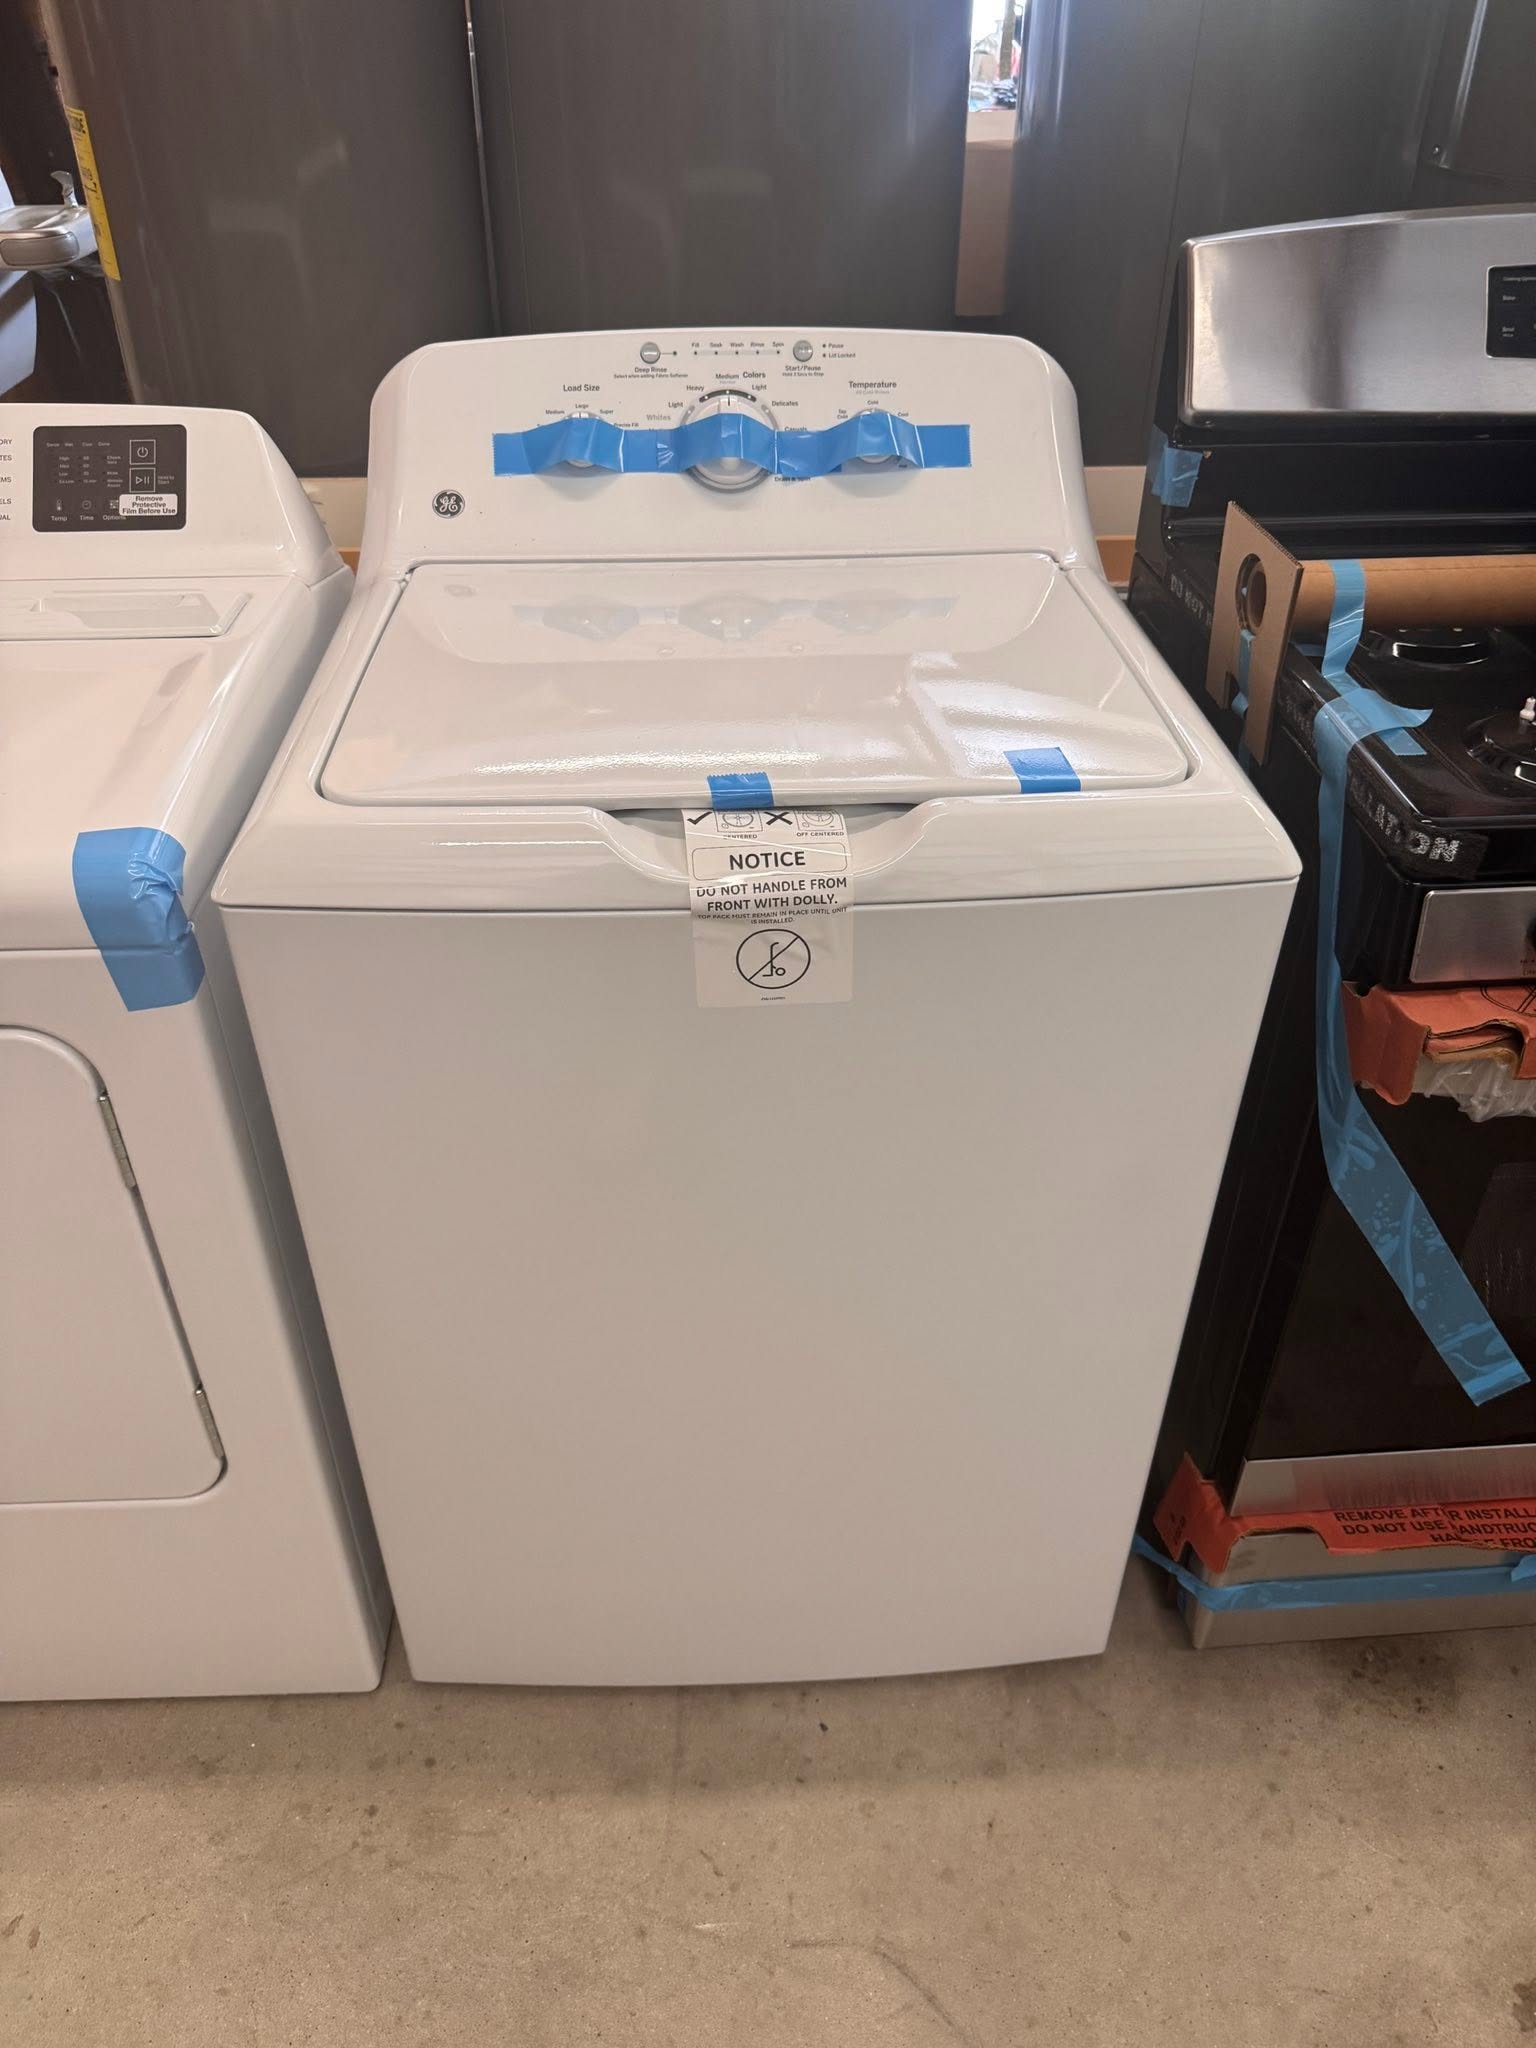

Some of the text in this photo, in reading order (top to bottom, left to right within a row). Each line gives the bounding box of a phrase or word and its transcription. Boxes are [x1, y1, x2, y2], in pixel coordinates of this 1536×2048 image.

[742, 371, 766, 379] Colors
[563, 384, 600, 392] Load Size
[686, 384, 704, 392] Heavy
[751, 384, 767, 392] Light
[848, 380, 897, 389] Temperature
[668, 401, 683, 409] Light
[729, 851, 806, 871] NOTICE
[696, 877, 847, 897] DO NOT HANDLE FROM
[707, 893, 838, 912] FRONT WITH DOLLY.
[752, 911, 778, 919] REMAIN
[832, 906, 847, 914] UNIT
[1333, 1509, 1408, 1522] REMOVE
[1464, 1507, 1536, 1521] INSTALL
[1342, 1524, 1370, 1535] DO
[1372, 1522, 1407, 1534] NOT
[1410, 1520, 1447, 1532] USE
[1500, 1536, 1536, 1549] FRO
